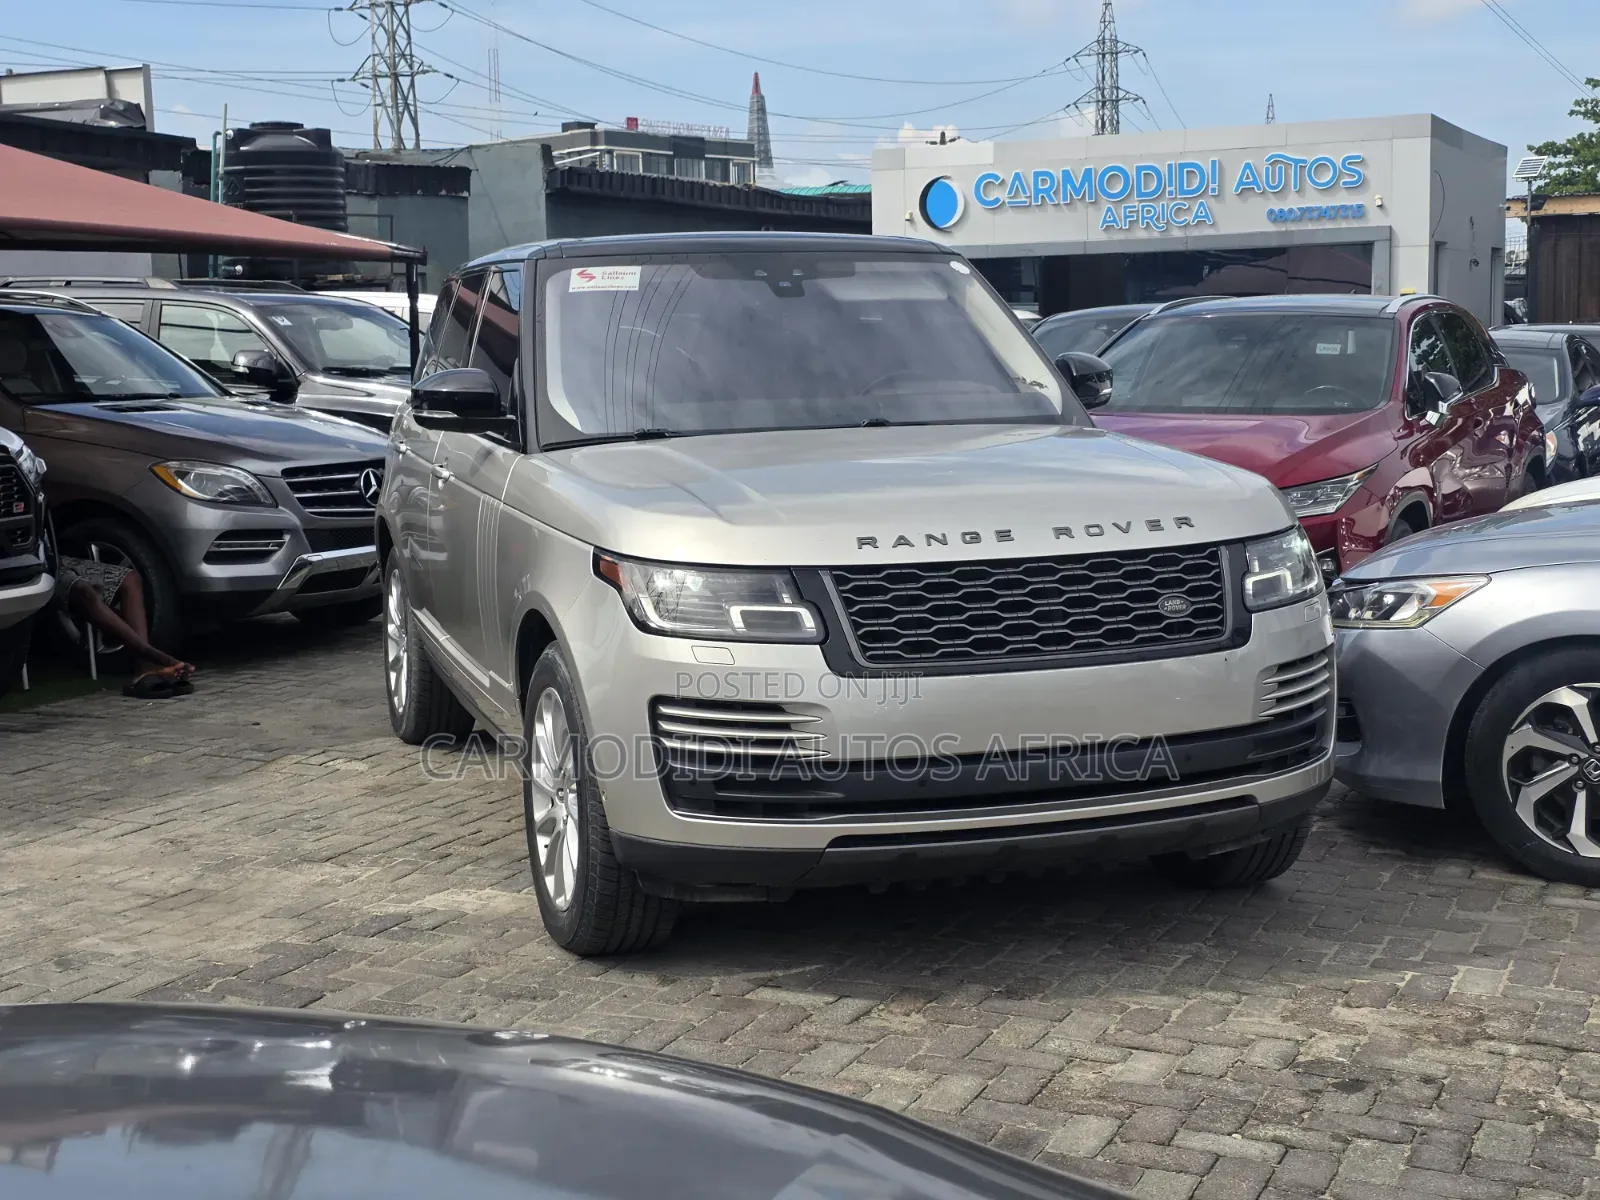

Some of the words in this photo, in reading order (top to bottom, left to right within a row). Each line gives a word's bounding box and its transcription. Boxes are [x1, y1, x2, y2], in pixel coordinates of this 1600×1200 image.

[1232, 151, 1364, 194] AUTOS
[1099, 200, 1213, 231] AFRICA
[856, 529, 1014, 549] RANGE
[1052, 515, 1195, 540] ROVER
